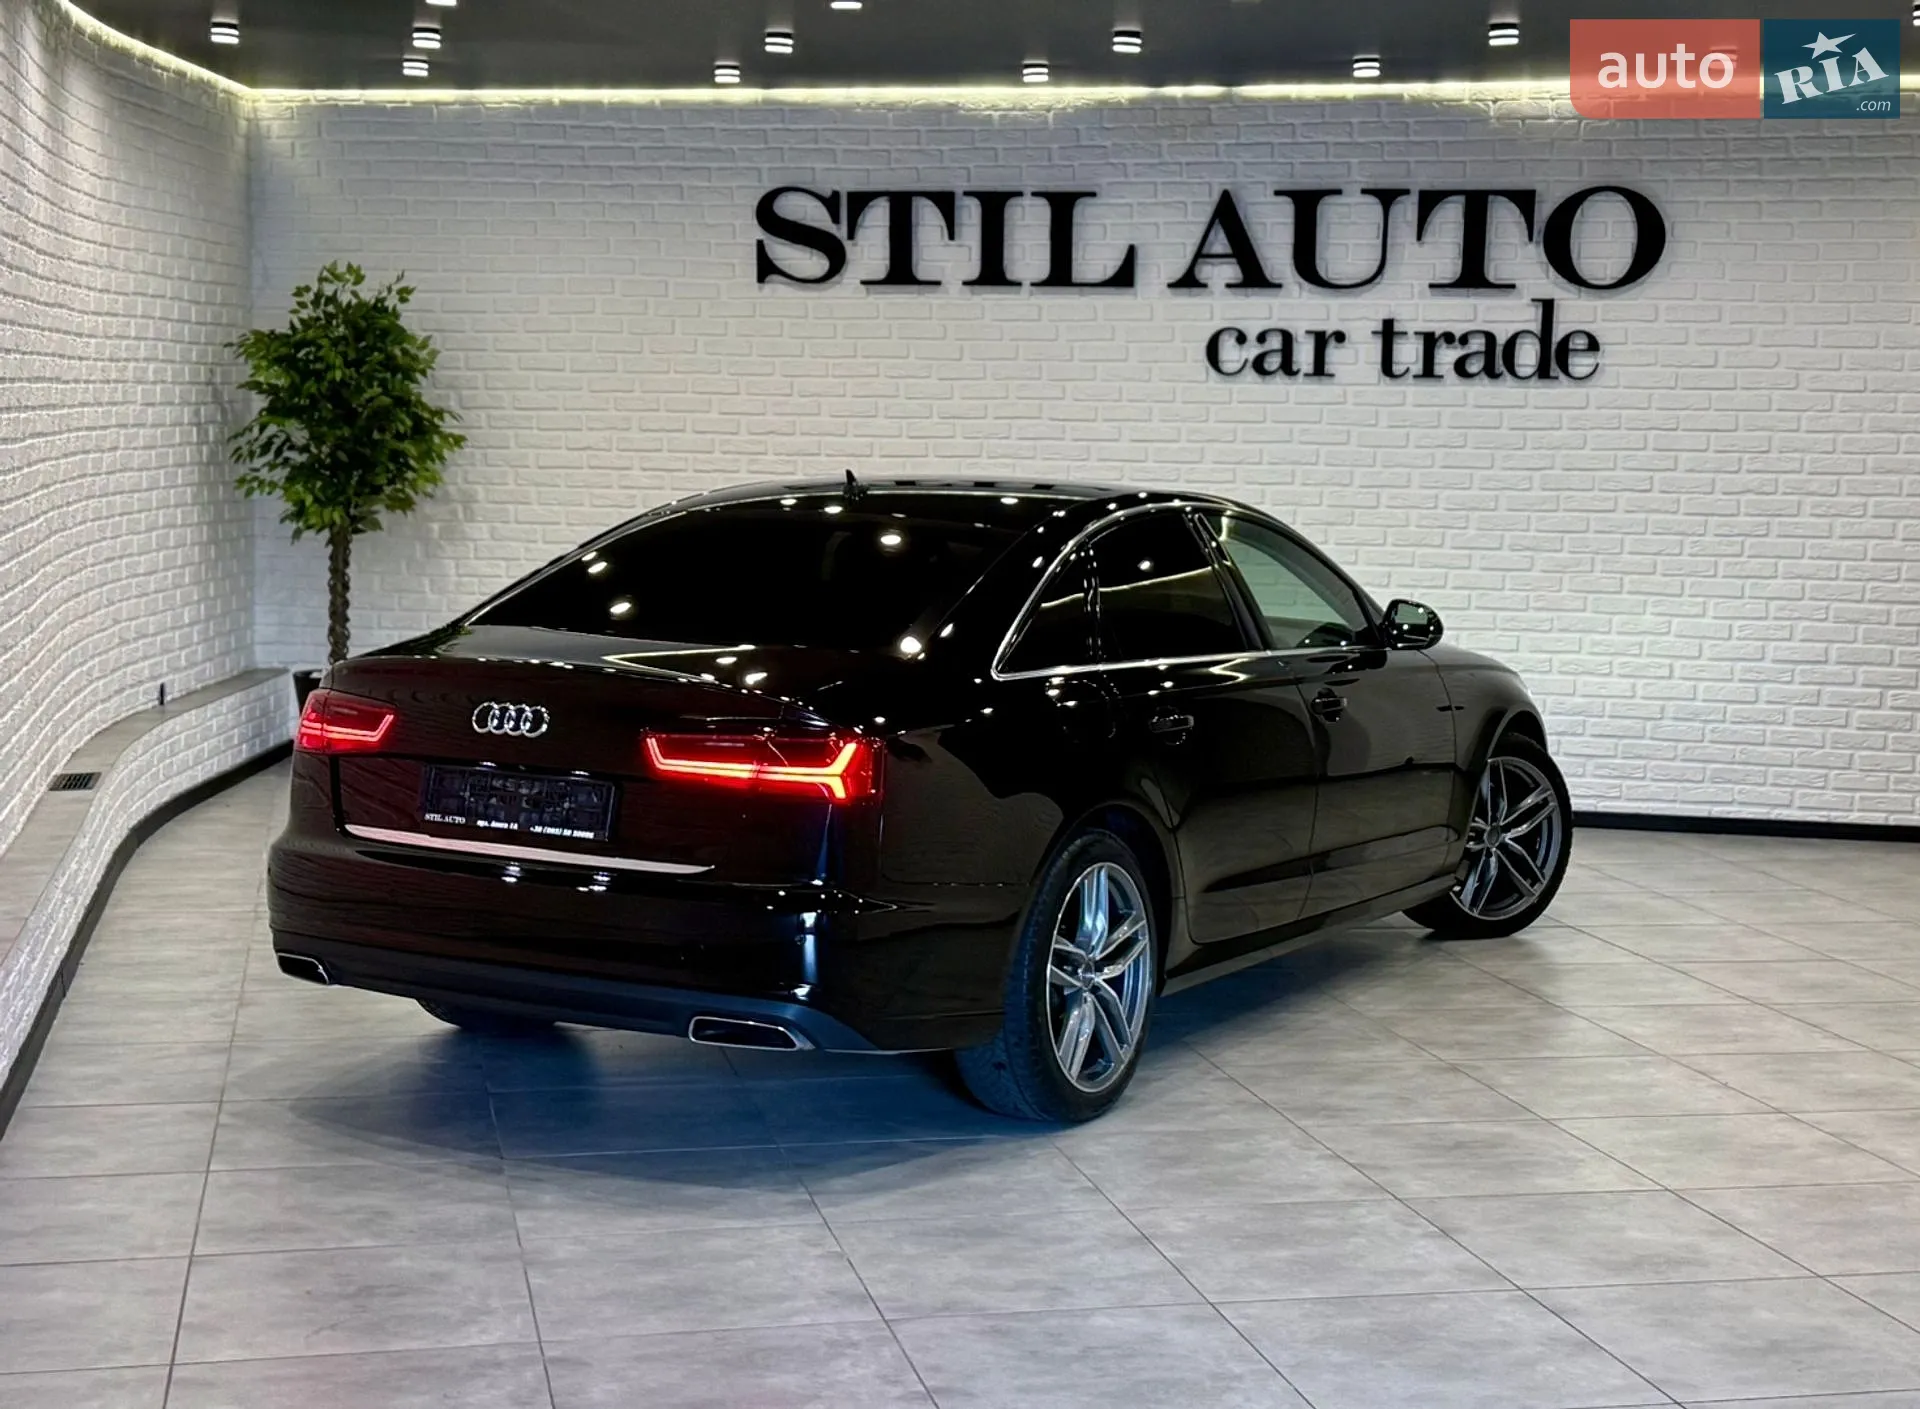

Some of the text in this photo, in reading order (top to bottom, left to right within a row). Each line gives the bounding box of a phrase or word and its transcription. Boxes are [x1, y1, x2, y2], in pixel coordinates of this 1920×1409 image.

[756, 185, 1666, 290] STIL AUTO
[1206, 298, 1600, 380] car trade
